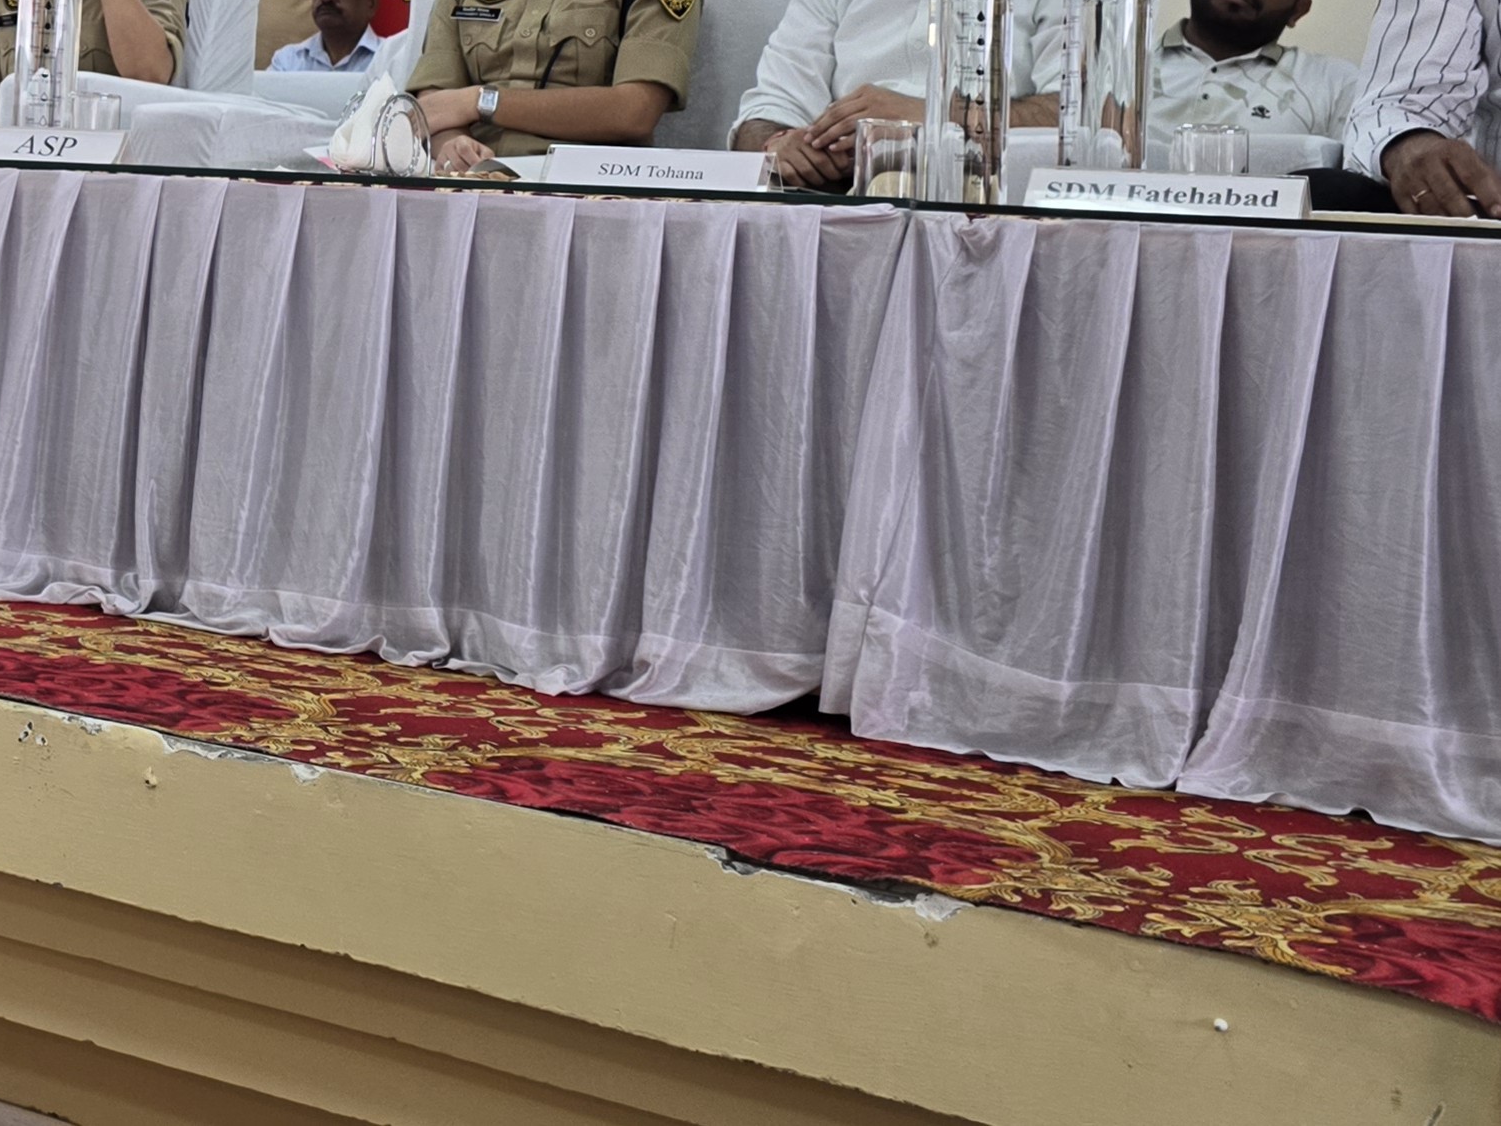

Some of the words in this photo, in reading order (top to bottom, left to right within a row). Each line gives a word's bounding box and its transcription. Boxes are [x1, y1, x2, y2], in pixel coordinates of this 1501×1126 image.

[13, 134, 78, 157] ASP
[597, 162, 641, 177] SDM
[646, 164, 704, 181] Tohana
[1044, 181, 1116, 202] SDM
[1127, 183, 1280, 208] Fatehabad
